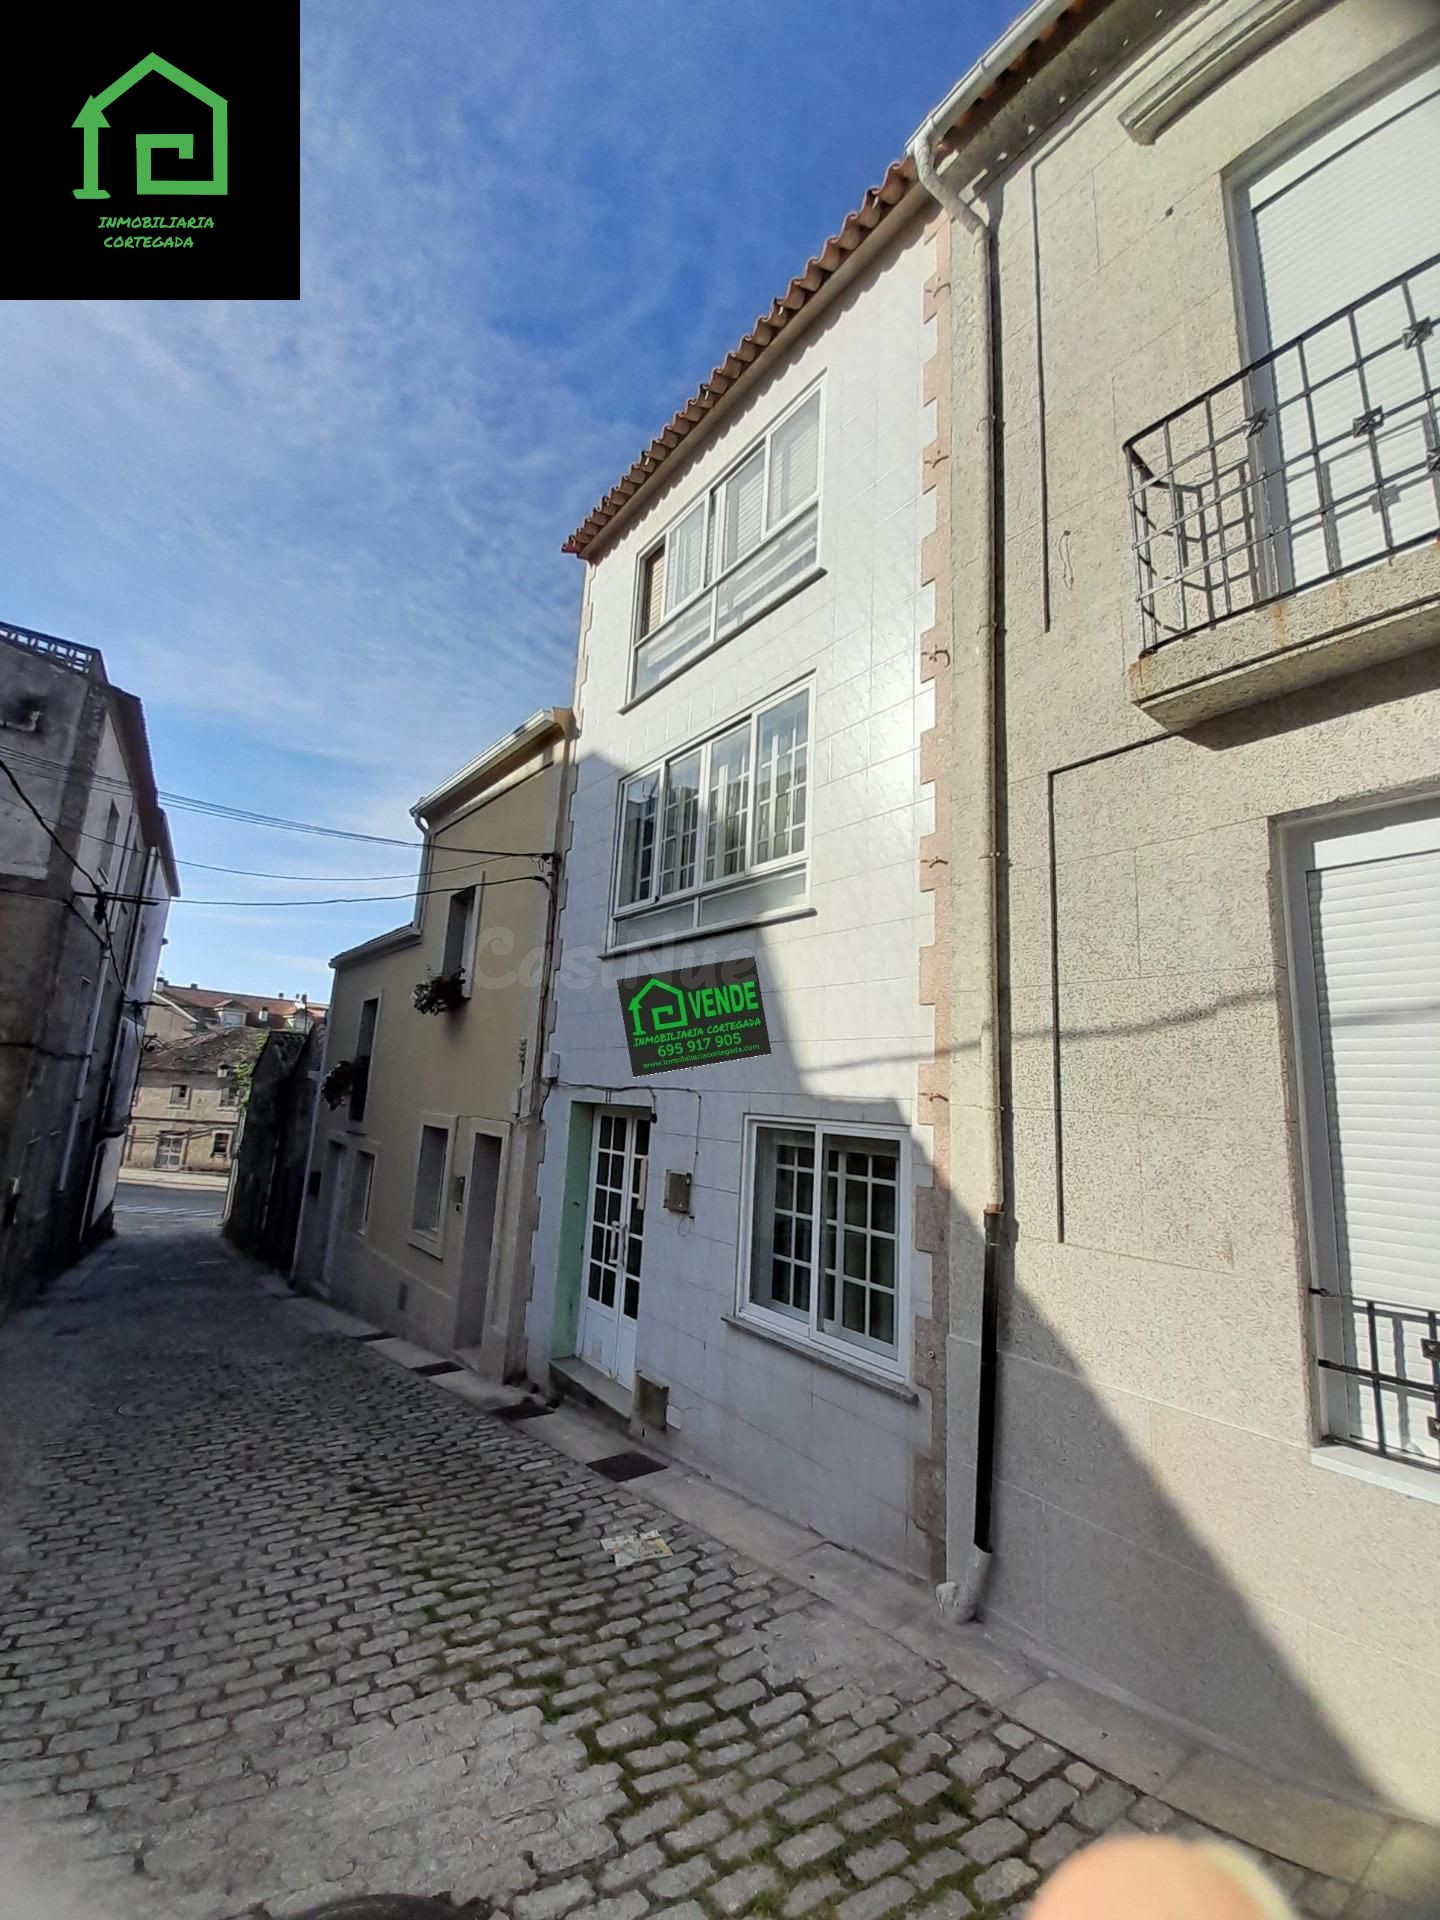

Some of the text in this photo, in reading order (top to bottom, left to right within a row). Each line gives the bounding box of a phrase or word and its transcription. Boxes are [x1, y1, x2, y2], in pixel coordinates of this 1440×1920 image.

[687, 981, 759, 1019] VENDE
[633, 1017, 762, 1047] INMOBILIARIA CORTEGADA
[657, 1032, 742, 1058] 695 917 905
